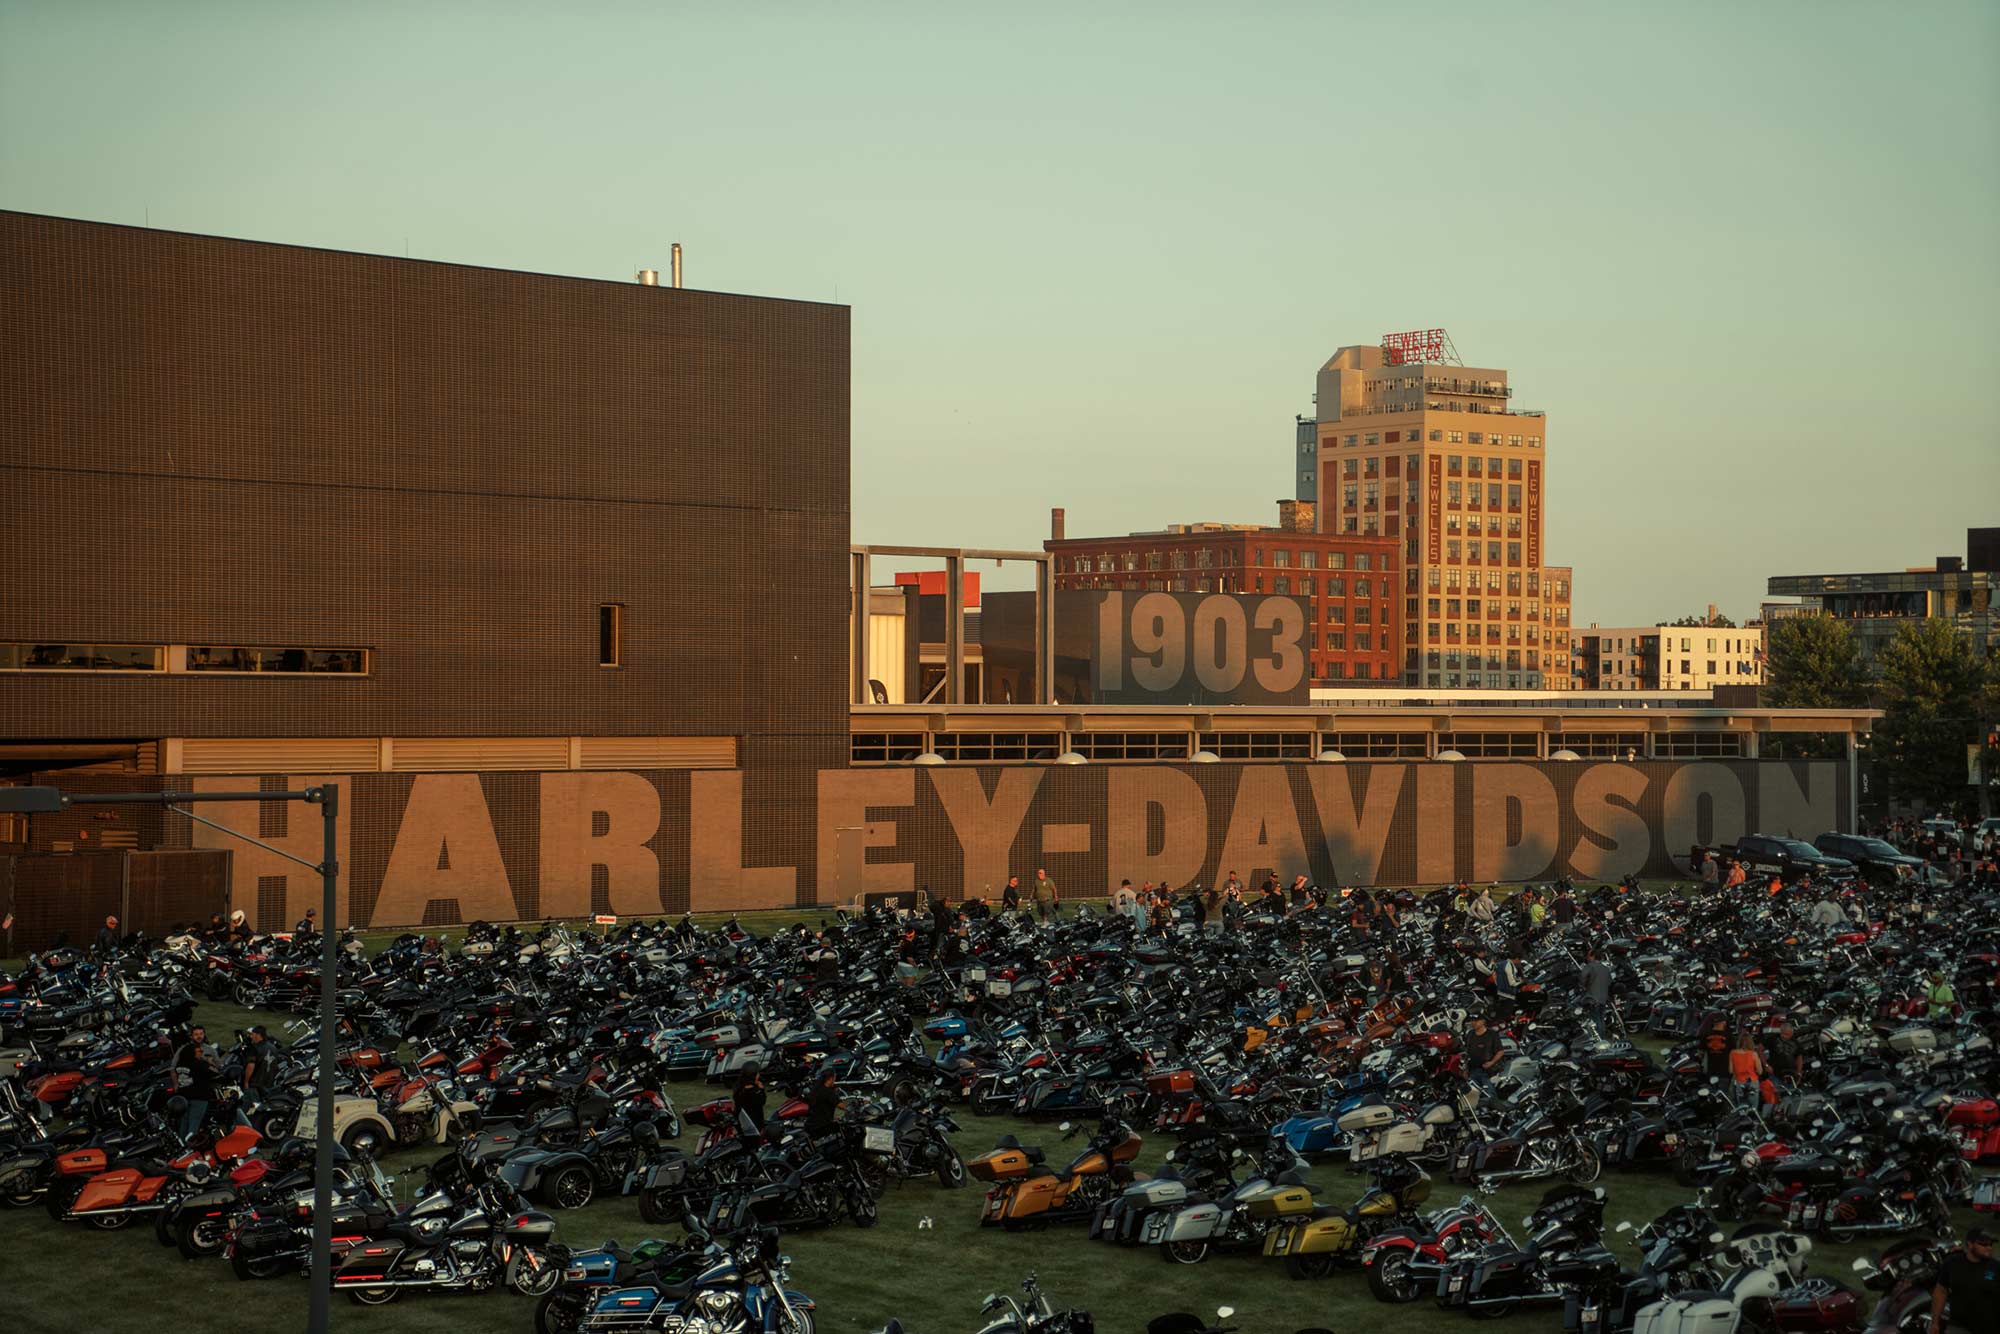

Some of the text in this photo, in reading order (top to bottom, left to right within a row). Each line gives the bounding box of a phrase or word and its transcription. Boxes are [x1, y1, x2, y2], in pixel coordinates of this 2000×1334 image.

[1386, 329, 1442, 352] TEWELES
[1430, 459, 1439, 560] TEWELES
[1529, 465, 1538, 564] TEWELES
[1099, 591, 1304, 693] 1903
[192, 761, 1837, 931] HARLEY-DAVIDSON
